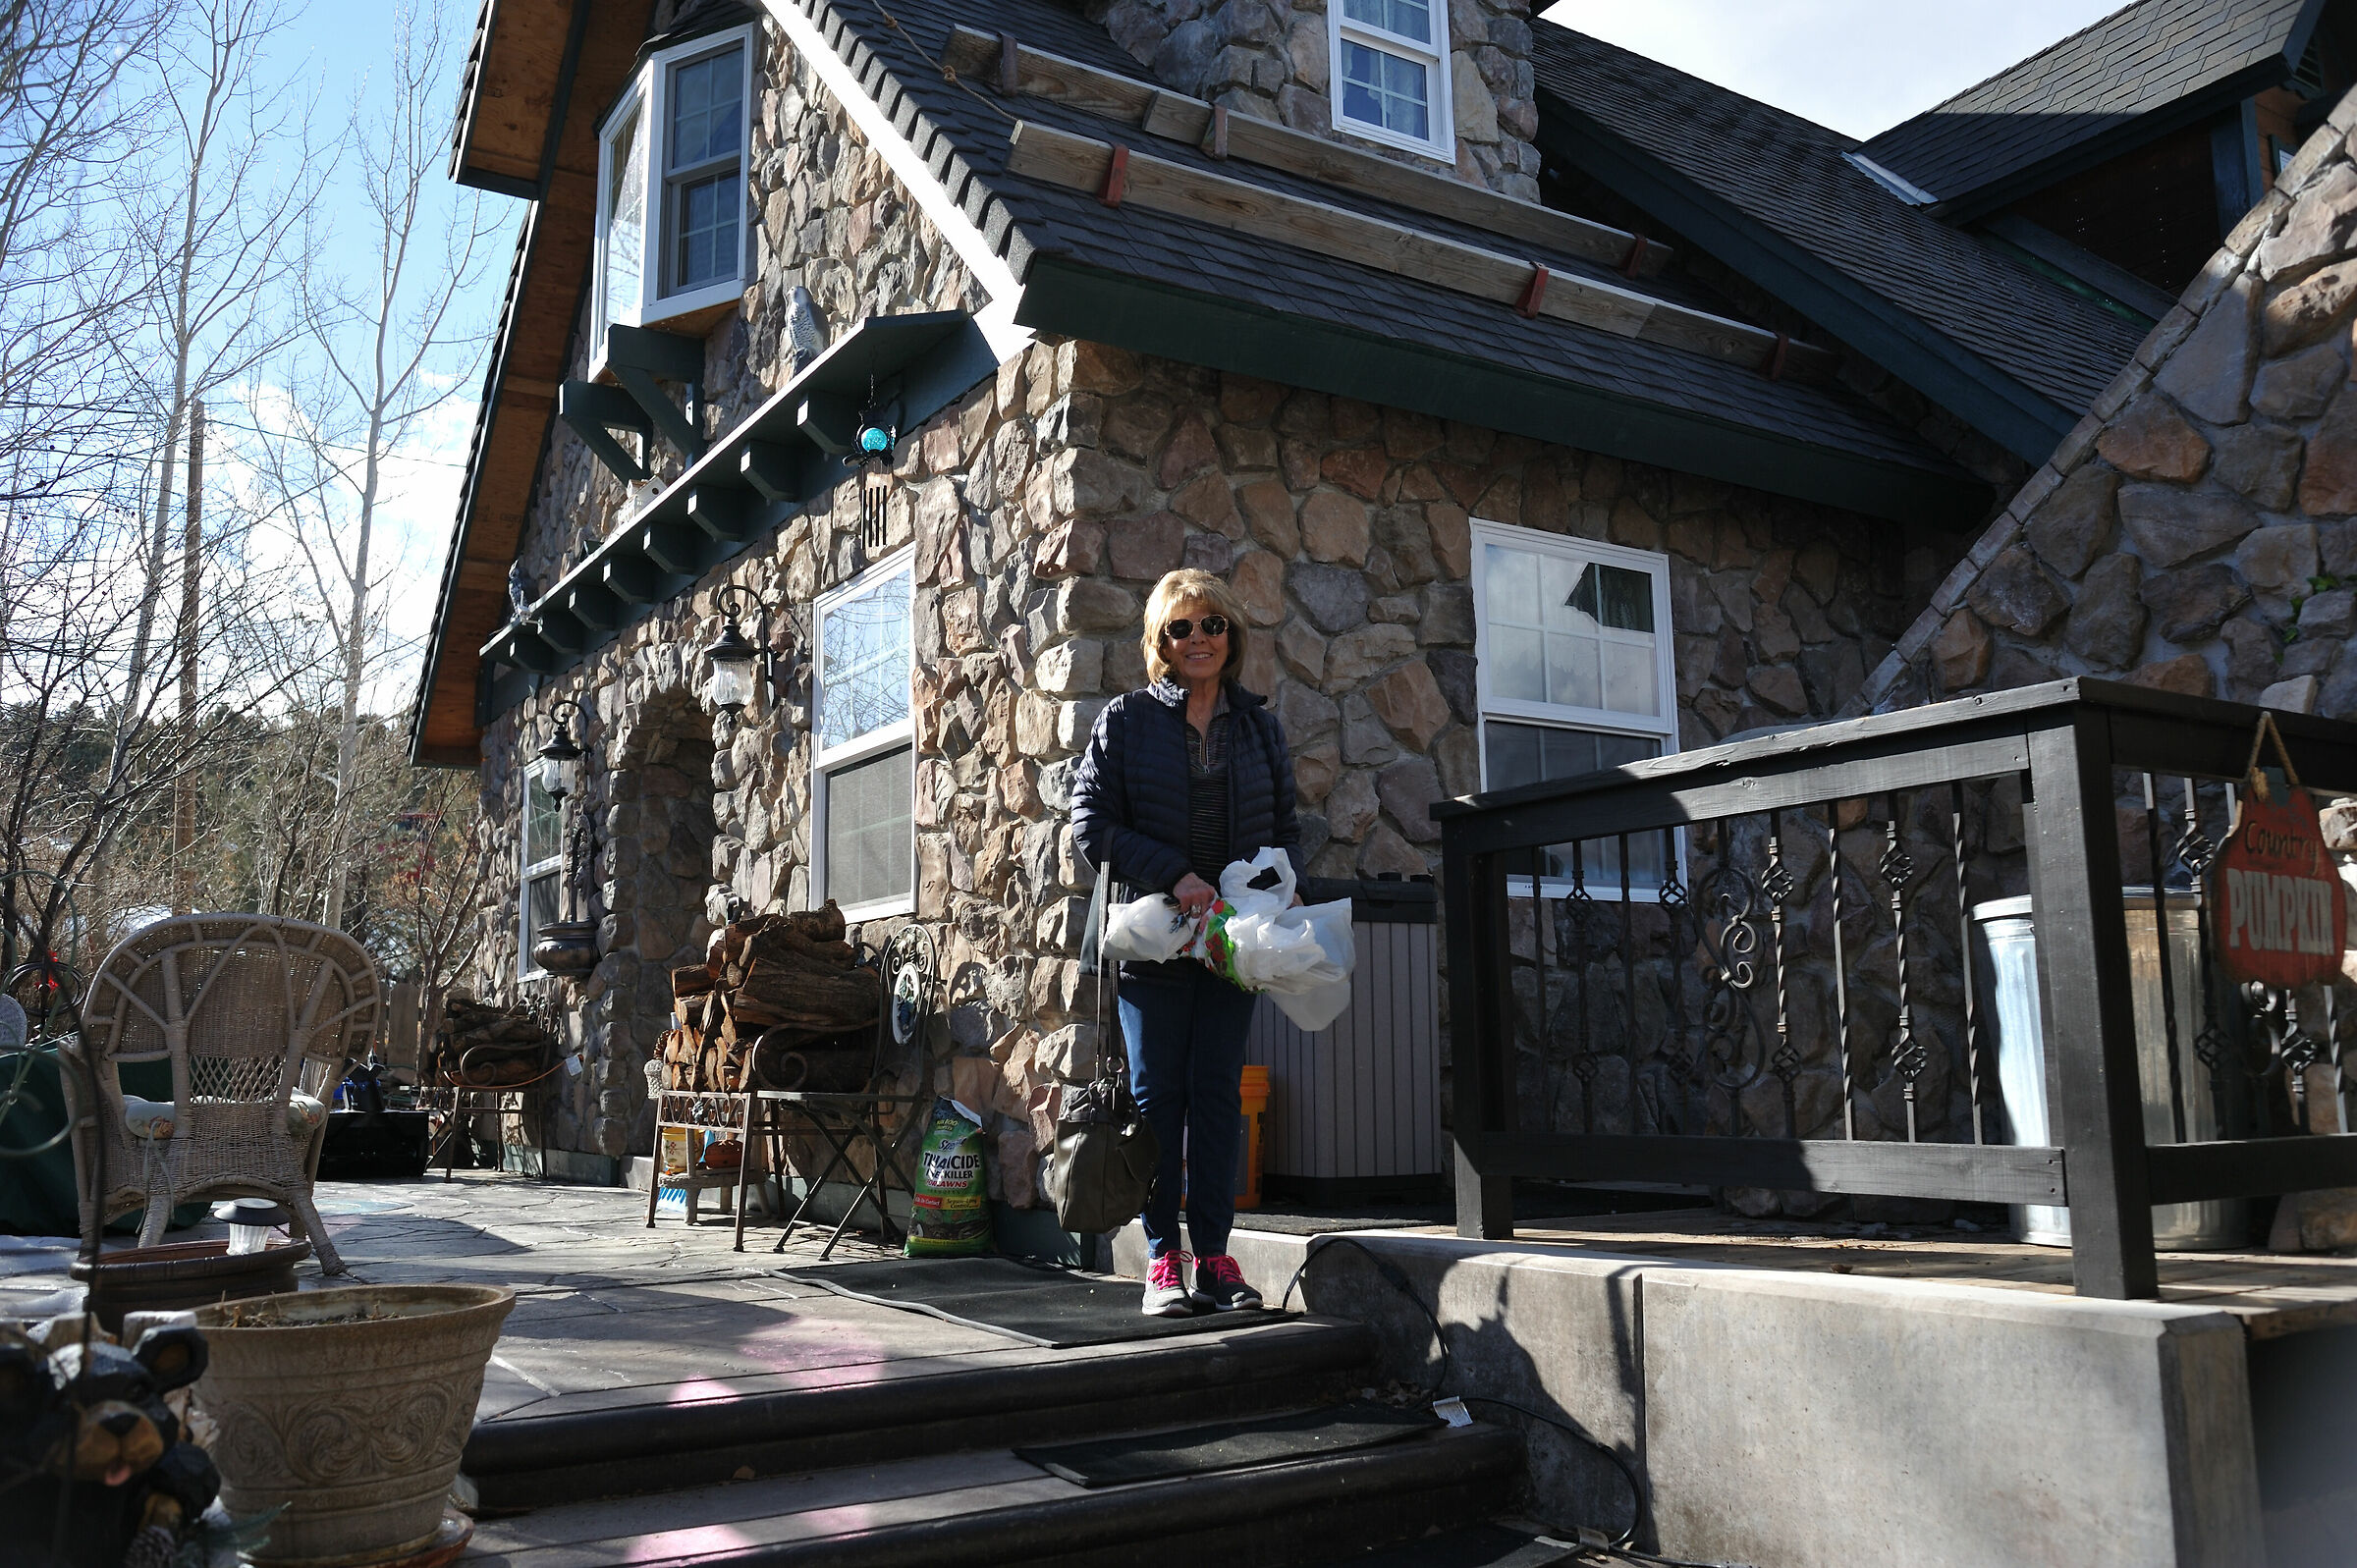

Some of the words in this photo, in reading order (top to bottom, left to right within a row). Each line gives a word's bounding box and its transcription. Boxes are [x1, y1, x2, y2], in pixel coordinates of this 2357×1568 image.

[2245, 821, 2319, 876] Country
[2226, 868, 2334, 955] PUMPKIN
[945, 1169, 973, 1179] KILLER
